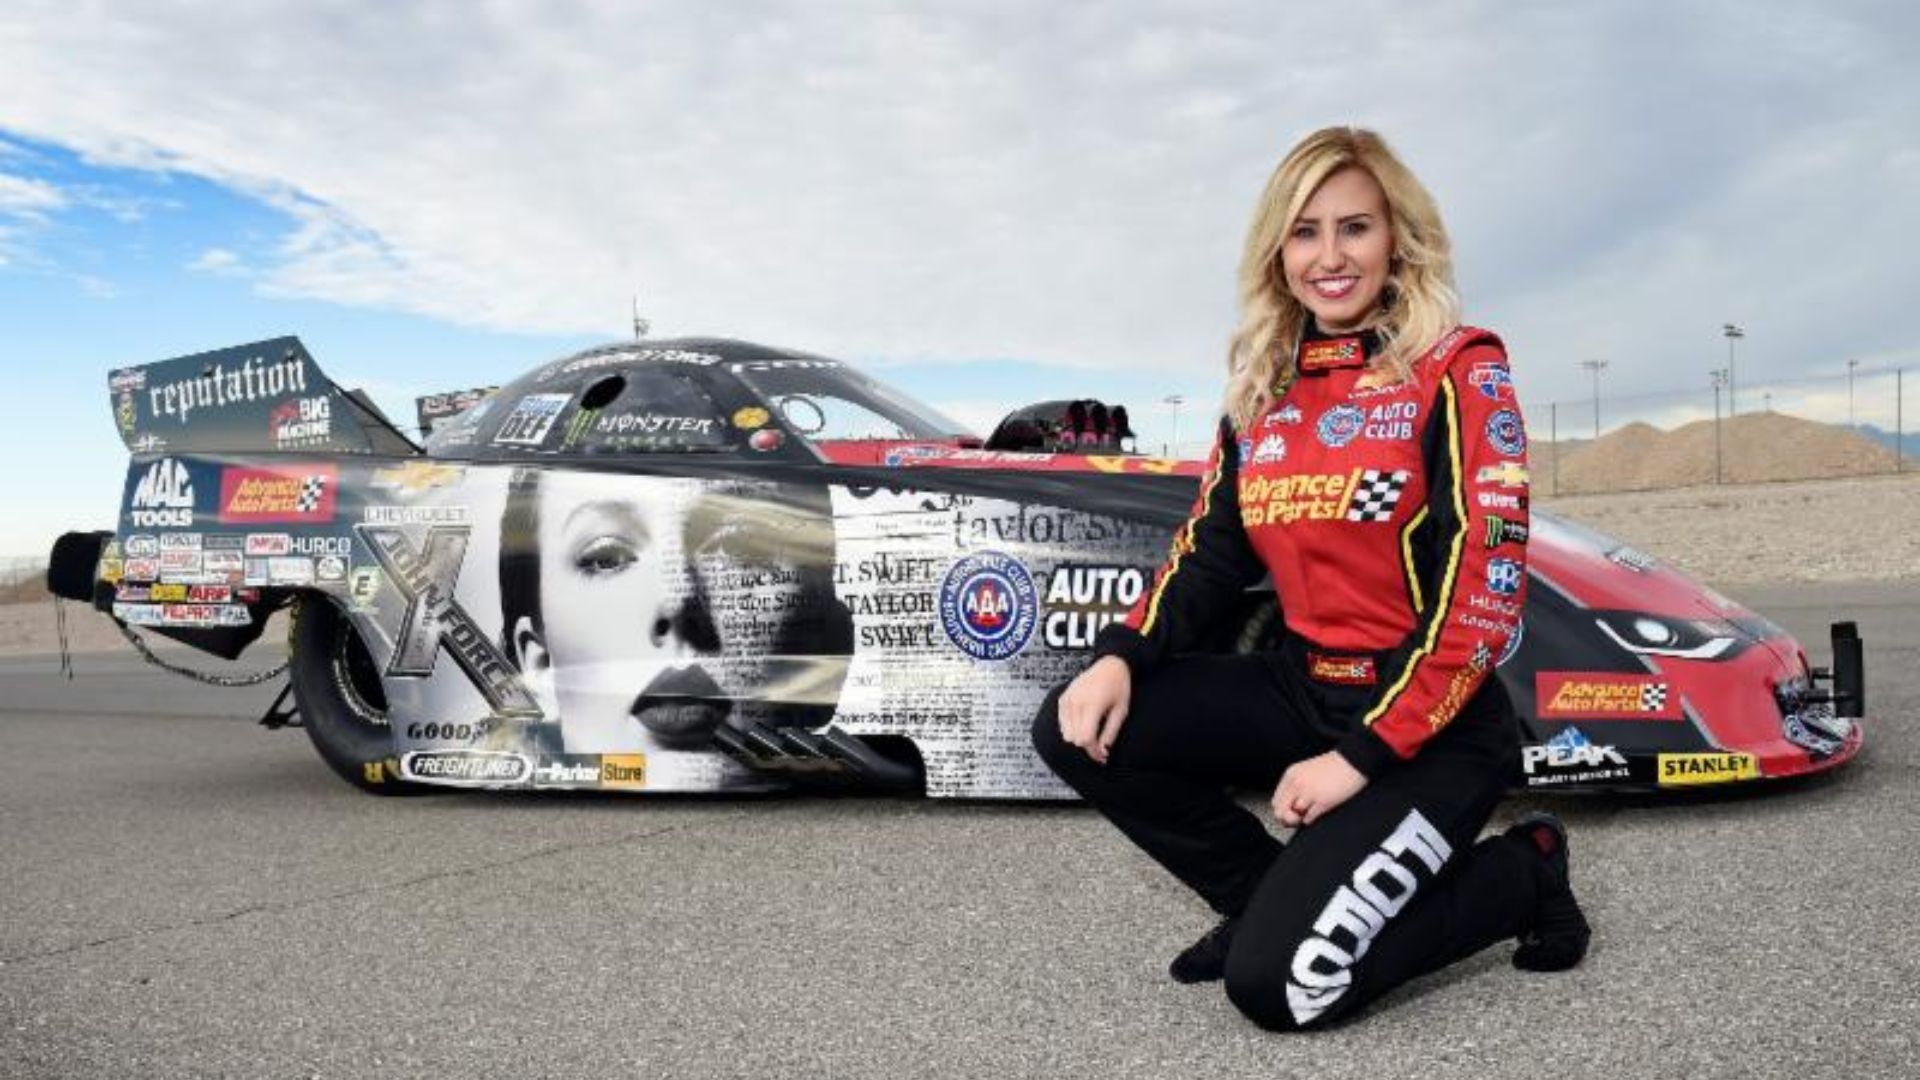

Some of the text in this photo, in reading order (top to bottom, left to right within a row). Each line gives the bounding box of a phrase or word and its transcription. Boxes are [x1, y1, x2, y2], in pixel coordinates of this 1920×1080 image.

[151, 356, 306, 423] reputation
[299, 396, 330, 420] BIG
[1370, 402, 1417, 420] AUTO
[277, 420, 329, 440] MACHINE
[597, 413, 713, 435] MONSTER
[1365, 422, 1412, 440] CLUB
[132, 458, 195, 507] MAC
[236, 478, 298, 497] Advance
[132, 509, 193, 527] TOOLS
[1266, 497, 1337, 525] Parts
[290, 537, 351, 553] HURCO
[190, 585, 229, 600] ARP
[1046, 568, 1144, 606] AUTO
[845, 592, 934, 615] TAYLOR
[966, 588, 1010, 616] AAA
[861, 623, 937, 647] SWIFT
[1045, 612, 1129, 647] CLU
[1556, 681, 1638, 698] Advance
[1548, 696, 1637, 711] Auto Parts
[414, 757, 523, 777] FREIGHTLINER
[1521, 744, 1629, 774] PEAK
[1664, 756, 1749, 776] STANLEY
[549, 762, 642, 782] Parker Store
[1286, 808, 1453, 1026] FORCE
